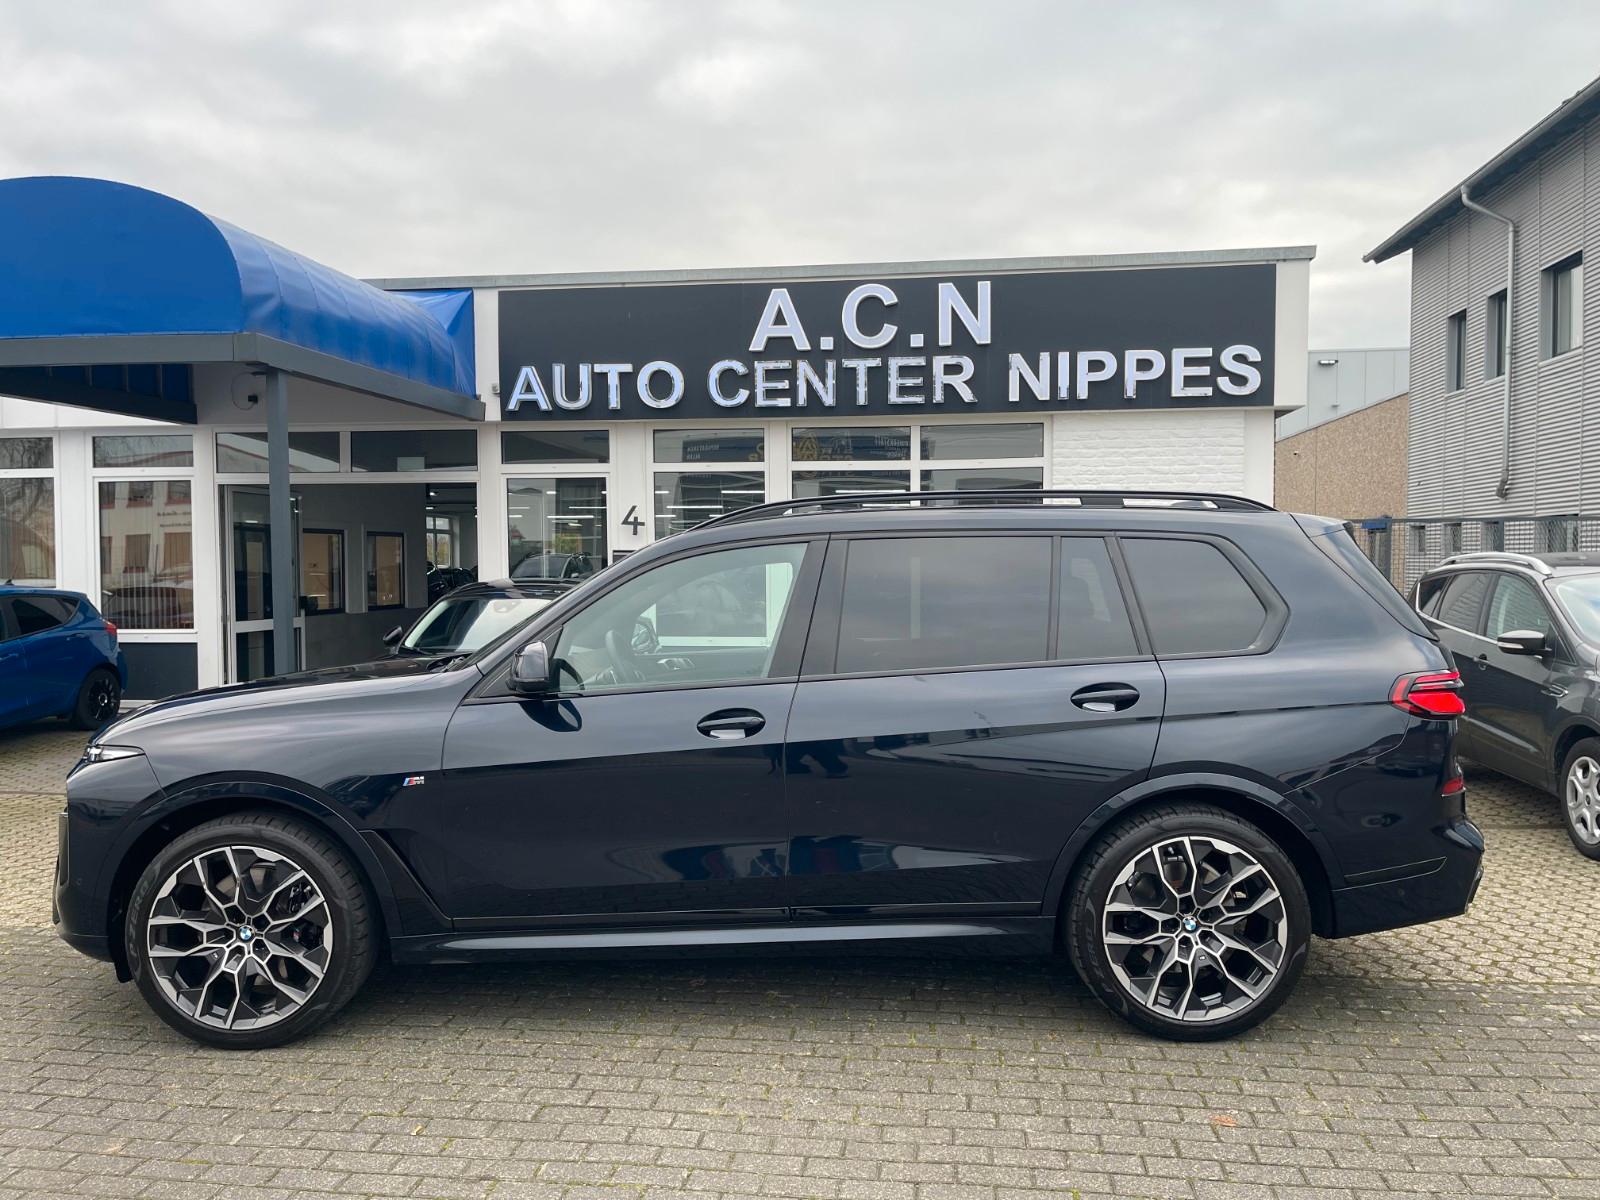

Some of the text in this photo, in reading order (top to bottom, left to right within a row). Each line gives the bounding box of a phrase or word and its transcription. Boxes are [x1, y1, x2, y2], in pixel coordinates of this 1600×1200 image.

[749, 281, 993, 354] A.C.N
[507, 345, 1263, 413] AUTO CENTER NIPPES
[621, 505, 645, 535] 4
